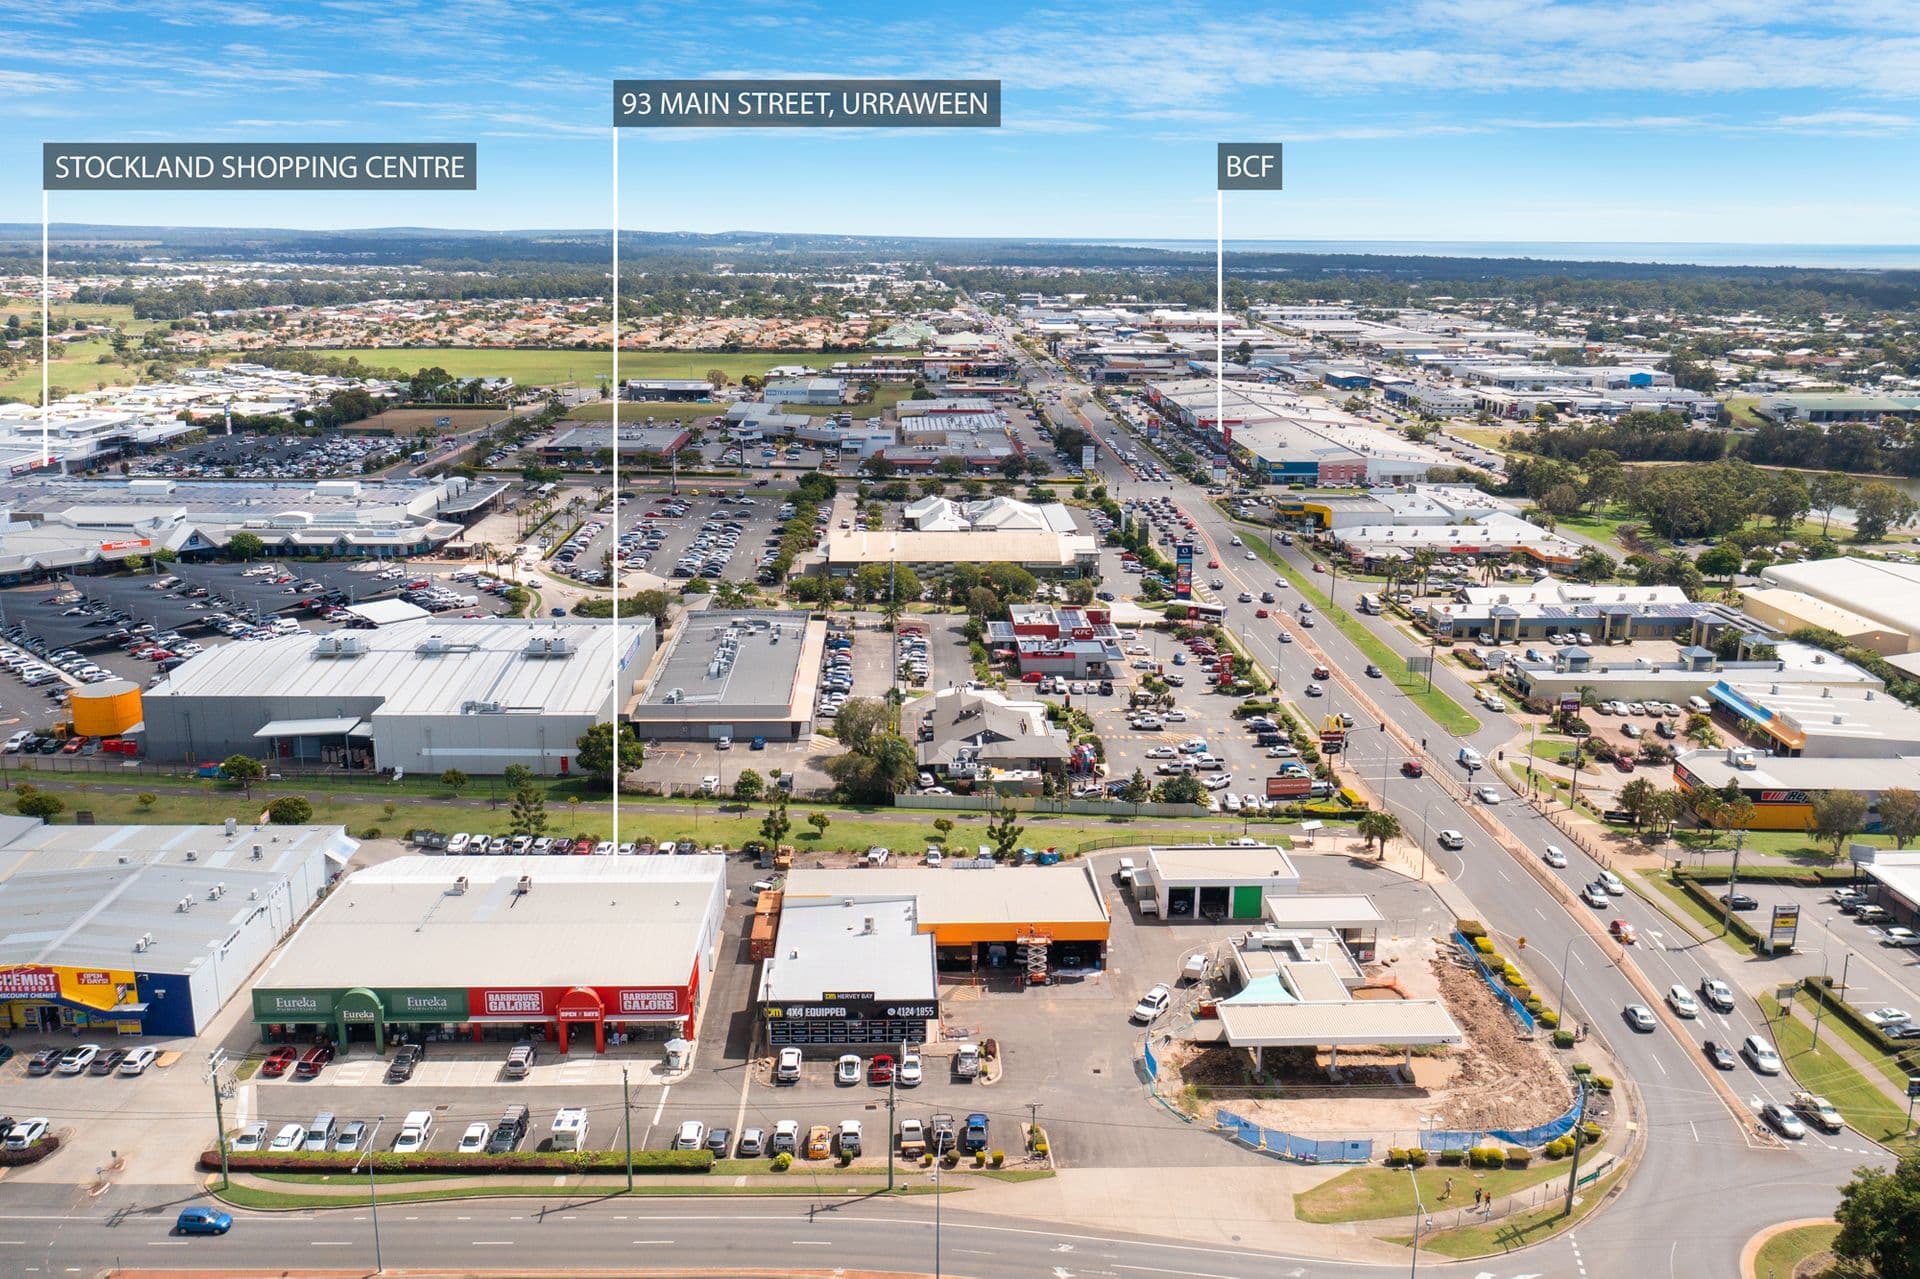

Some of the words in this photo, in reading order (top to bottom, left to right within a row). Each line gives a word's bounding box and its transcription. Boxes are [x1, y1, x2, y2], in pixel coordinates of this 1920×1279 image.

[0, 974, 55, 985] HEMIST
[407, 996, 447, 1007] Eureka
[488, 994, 540, 1002] BARBEQUES
[622, 993, 675, 1001] BARBEQUES
[276, 997, 317, 1008] Eureka
[489, 1001, 540, 1011] GALORE
[623, 1000, 675, 1011] GALORE
[343, 1010, 375, 1019] Eureka
[786, 1007, 804, 1017] 4X4
[805, 1007, 847, 1017] EQUIPPED
[896, 1007, 915, 1017] 4124
[916, 1007, 934, 1016] 1855
